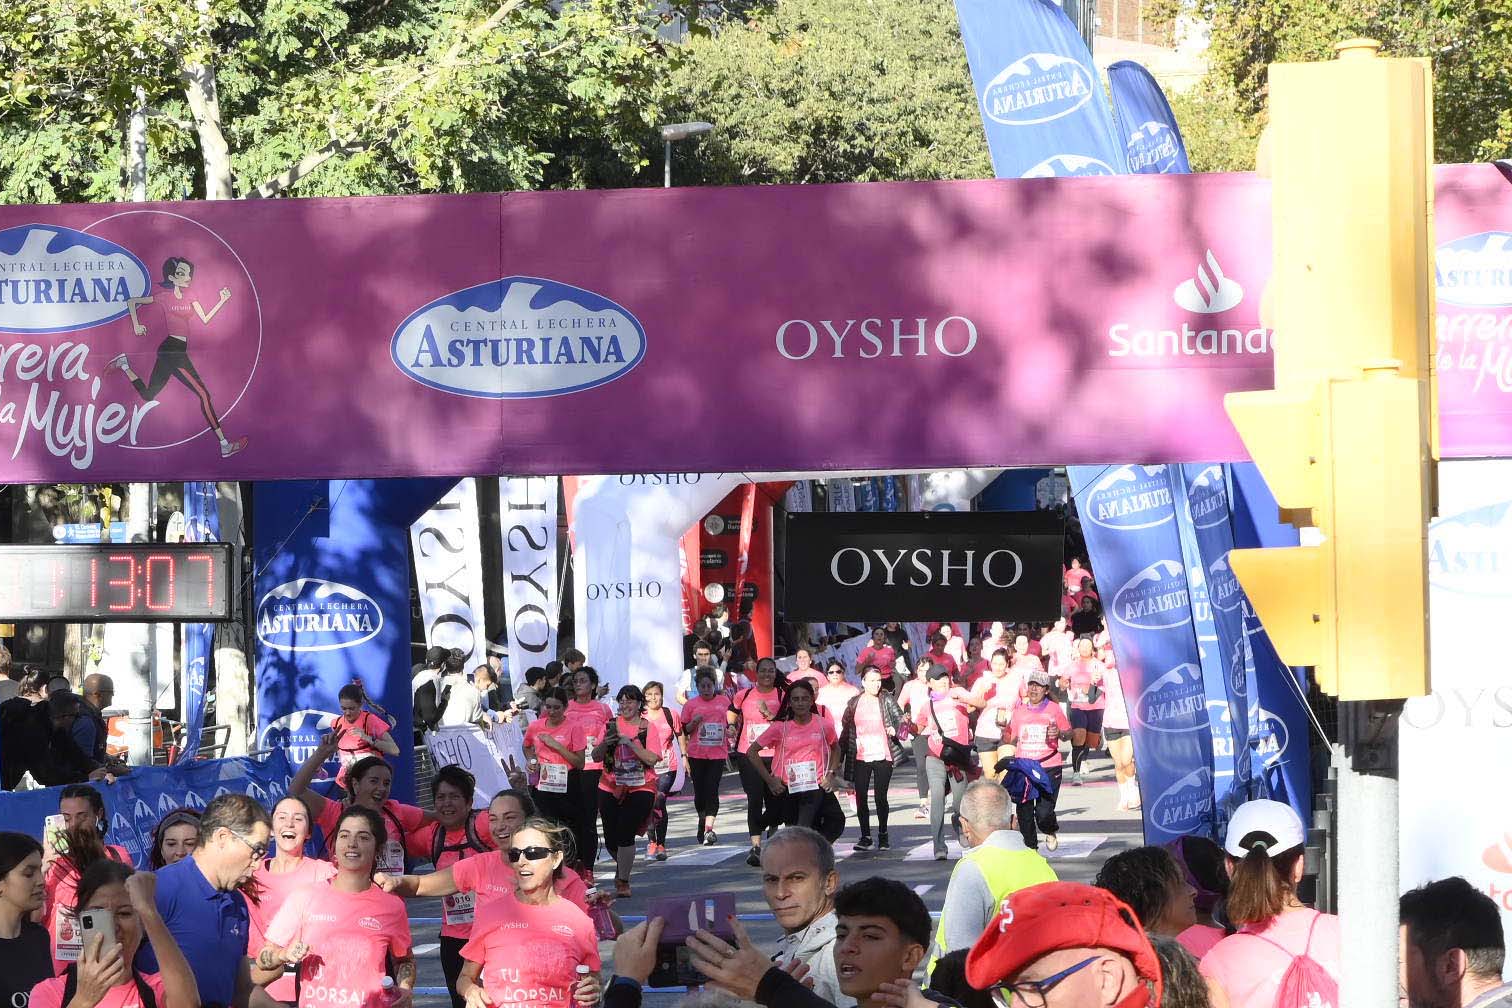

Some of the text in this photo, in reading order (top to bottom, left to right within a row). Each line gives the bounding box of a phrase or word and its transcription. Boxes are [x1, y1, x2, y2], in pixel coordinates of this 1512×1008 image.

[53, 259, 126, 272] LECHERA
[450, 316, 618, 333] CENTRAL LECHERA
[411, 324, 626, 369] ASTURIANA
[775, 315, 979, 360] OYSHO
[12, 376, 162, 470] Mujer
[830, 547, 1023, 588] OYSHO
[586, 581, 662, 601] OYSHO
[273, 602, 369, 612] CENTRAL LECHERA
[260, 608, 374, 635] ASTURIANA
[501, 967, 519, 983] TU
[305, 985, 366, 1006] DORSAL
